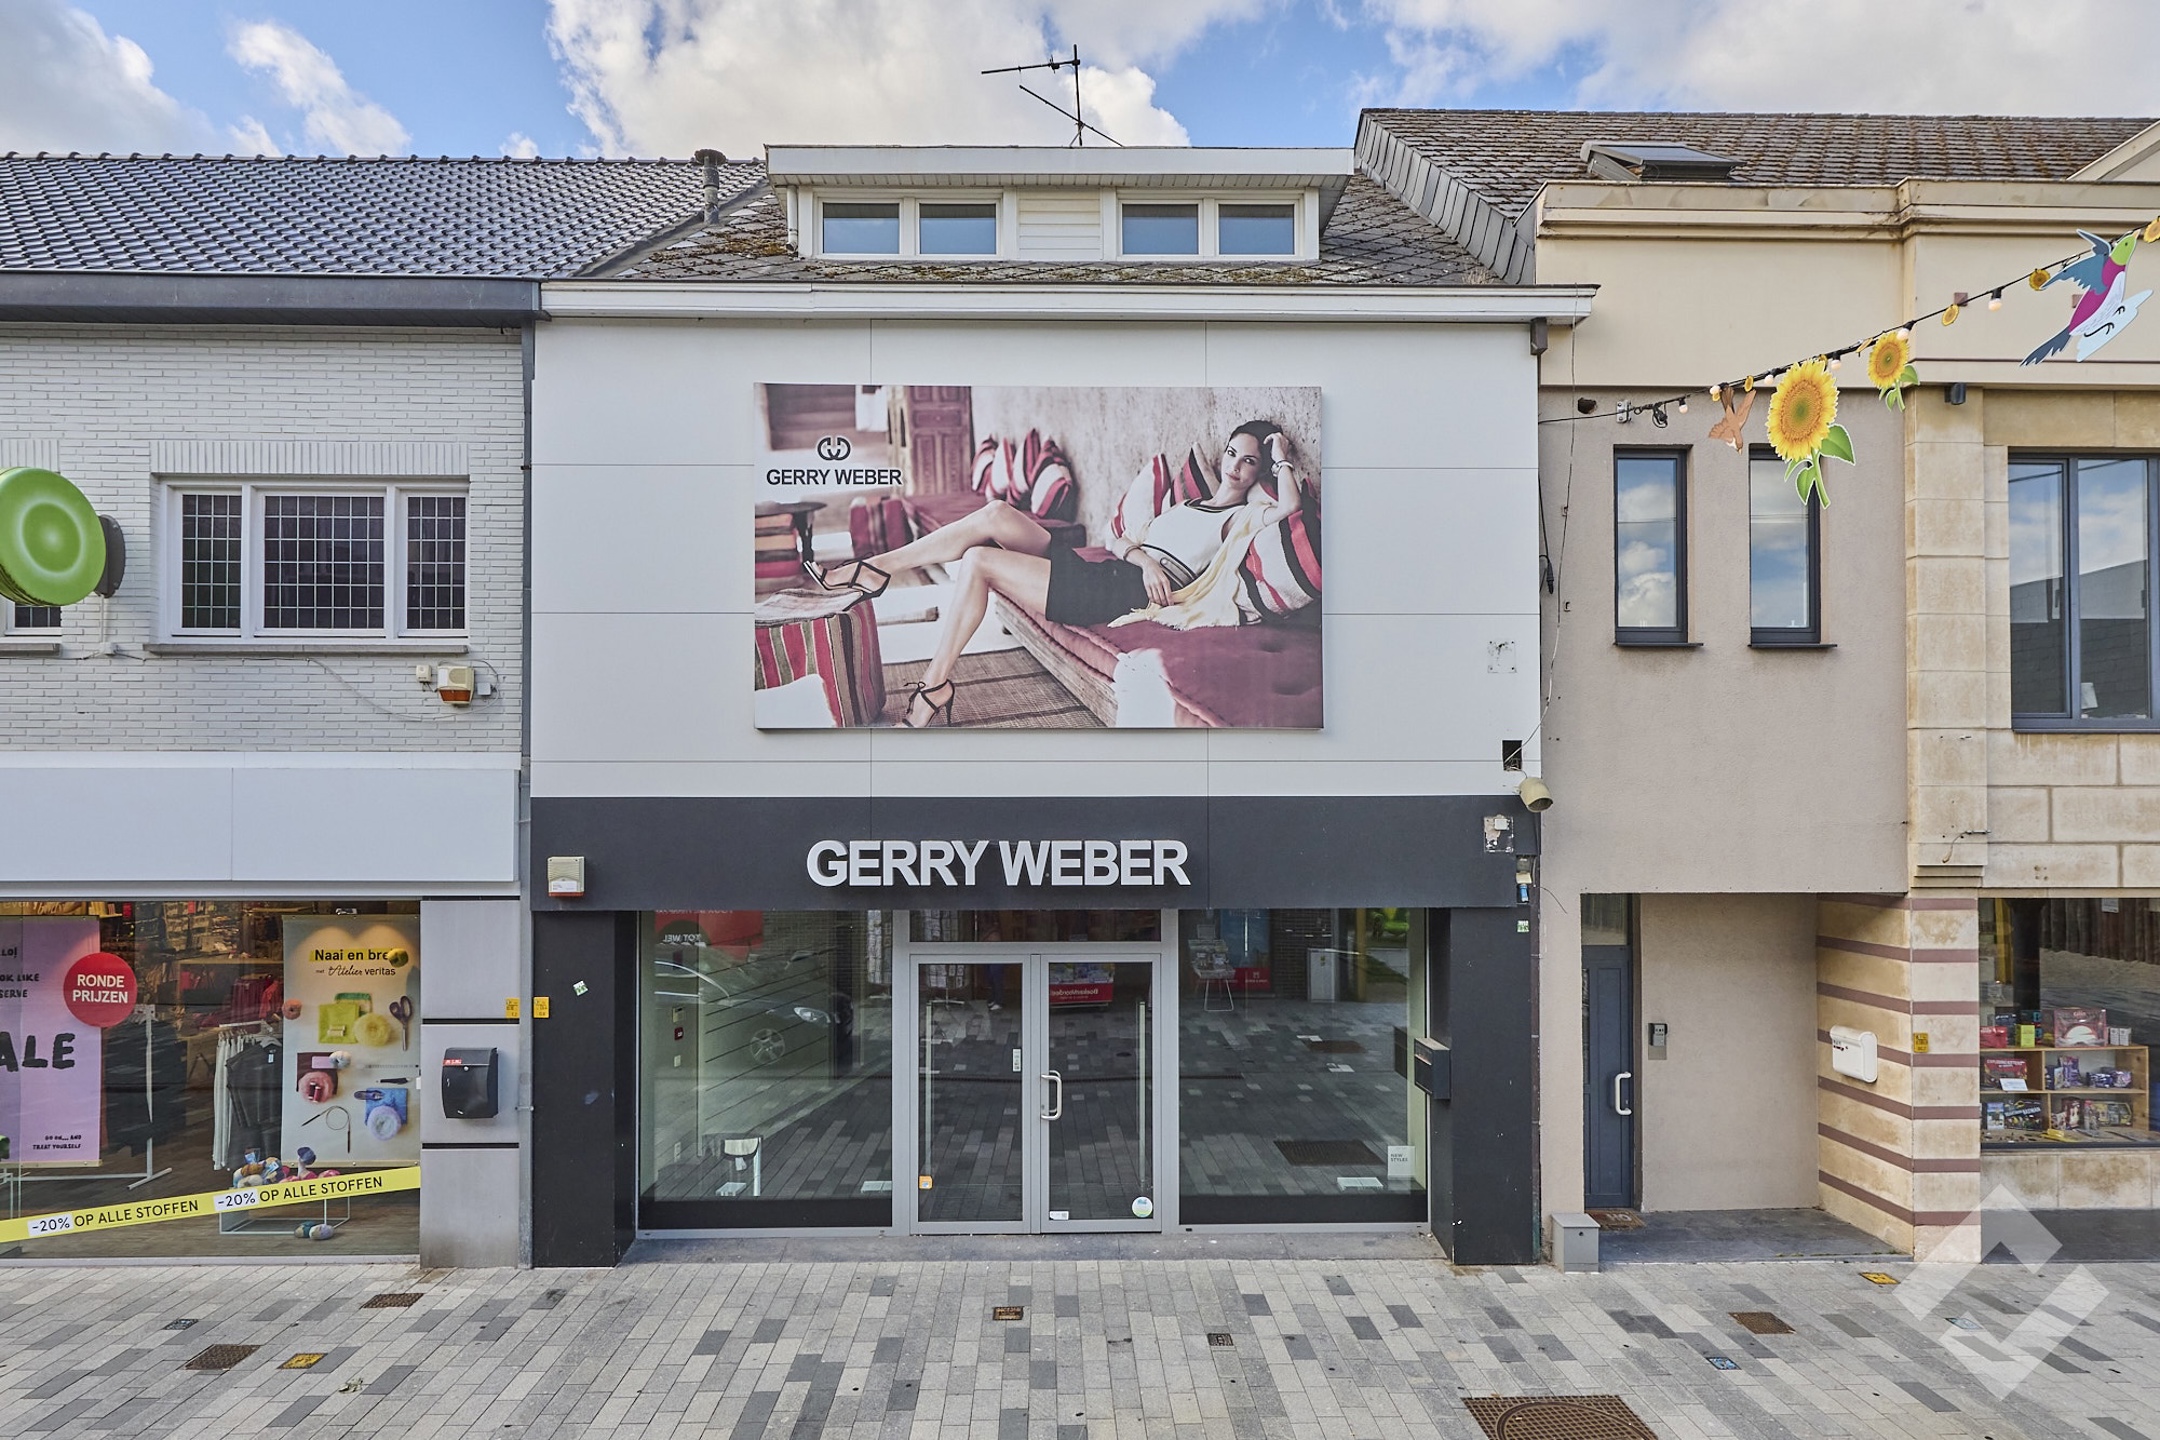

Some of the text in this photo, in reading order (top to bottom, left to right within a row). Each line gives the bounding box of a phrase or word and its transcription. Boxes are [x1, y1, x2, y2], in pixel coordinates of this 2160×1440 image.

[766, 469, 902, 485] GERRY WEBER
[806, 840, 1191, 887] GERRY WEBER
[315, 949, 344, 961] Naai
[347, 952, 364, 961] en
[17, 973, 39, 982] LIKE
[364, 967, 396, 976] veritas
[77, 974, 125, 988] RONDE
[72, 990, 128, 1004] PRIJZEN
[218, 1176, 383, 1207] -20% OP ALLE STOFFEN
[32, 1200, 199, 1232] -20% OP ALLE STOFFEN
